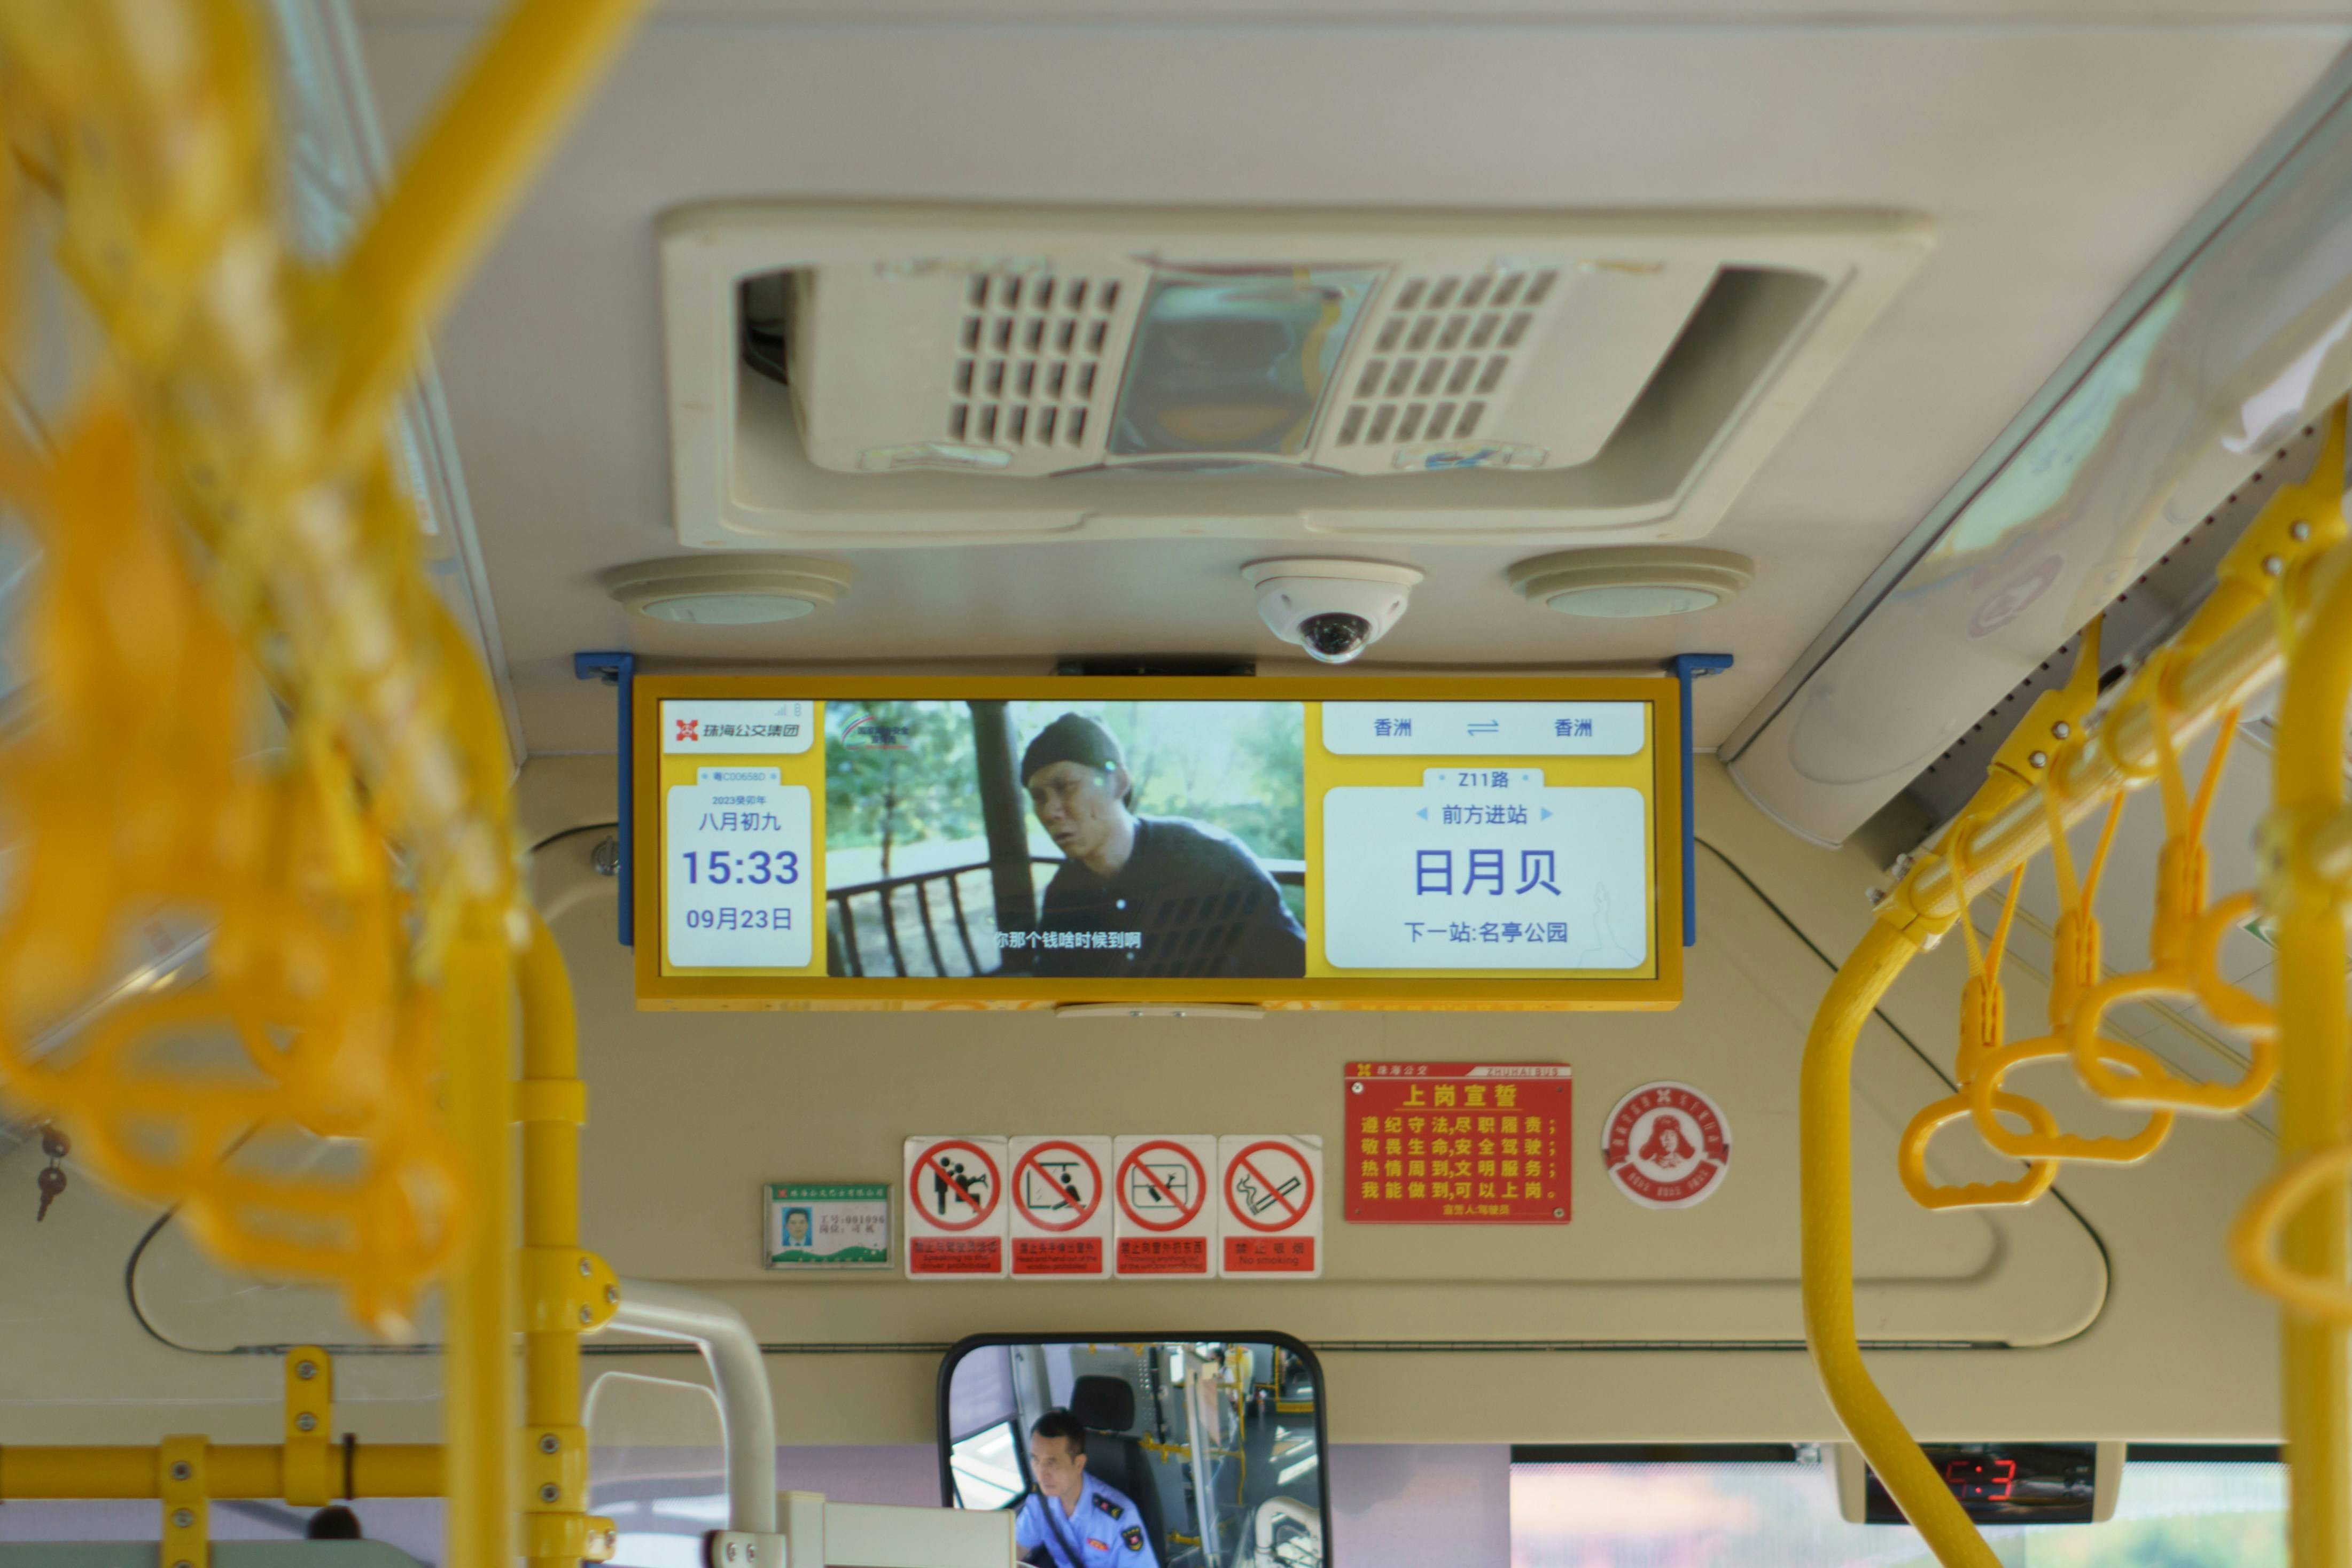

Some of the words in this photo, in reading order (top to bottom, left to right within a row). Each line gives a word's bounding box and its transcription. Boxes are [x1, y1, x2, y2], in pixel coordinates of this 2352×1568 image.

[703, 724, 799, 737] 珠海公交集团
[1374, 718, 1412, 737] 香洲
[1554, 718, 1593, 737] 香洲
[1458, 771, 1509, 788] Z11路
[712, 795, 766, 805] 2023癸卯年
[698, 812, 781, 831] 八月初九
[1442, 804, 1528, 825] 前方进站
[682, 851, 799, 884] 15:33
[1416, 849, 1562, 896] 日月贝
[686, 907, 791, 931] 09月23日
[994, 931, 1142, 948] 你那个钱啥时候到啊
[1404, 922, 1569, 943] 下一站:名亭公园
[1377, 1065, 1428, 1075] 珠海公交
[1487, 1068, 1532, 1076] ZHUHAI
[1536, 1068, 1559, 1076] BUS
[1403, 1084, 1518, 1107] 上岗宣誓
[1236, 1243, 1304, 1254] 禁止吸烟
[1257, 1256, 1300, 1266] smoking
